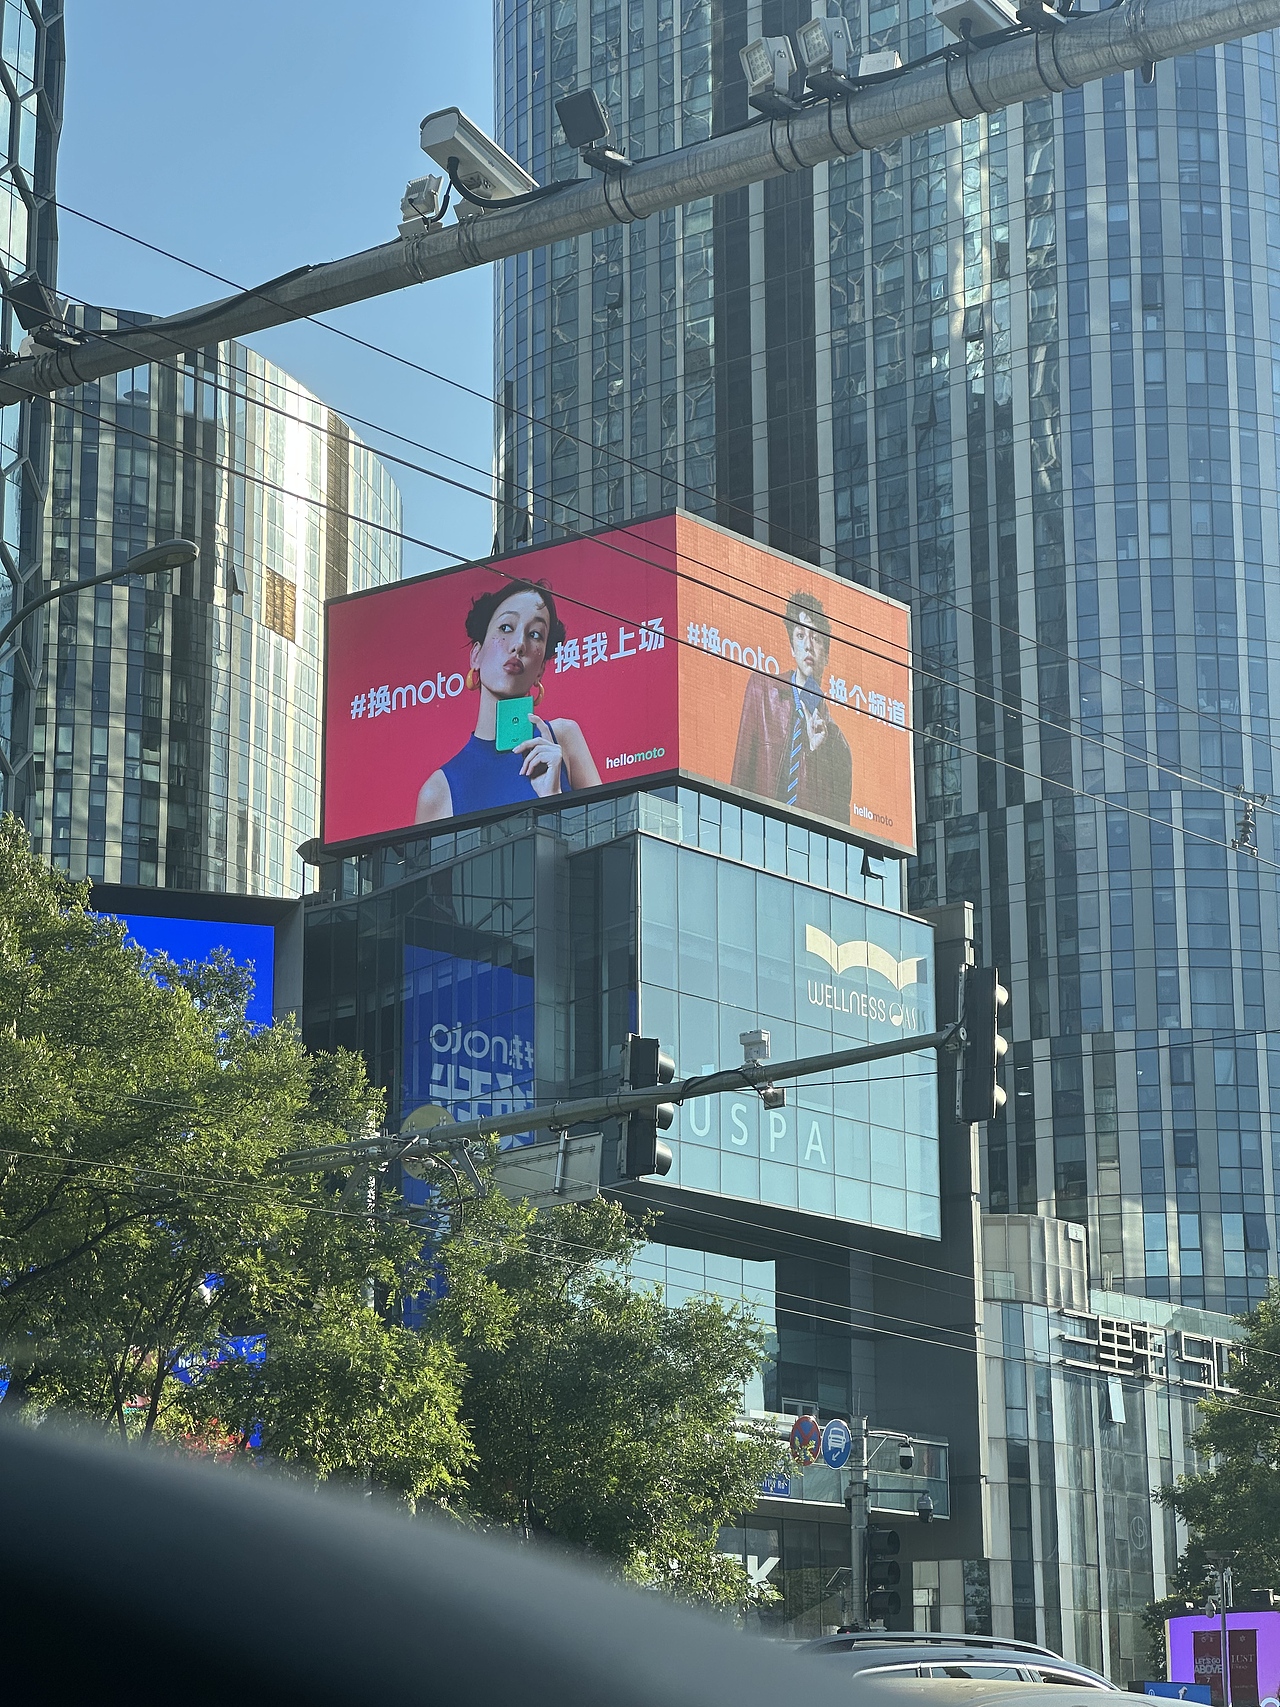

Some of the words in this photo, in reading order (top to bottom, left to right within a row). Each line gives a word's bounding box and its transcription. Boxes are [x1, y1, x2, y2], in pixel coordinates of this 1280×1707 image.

[350, 671, 465, 720] #换moto
[554, 616, 666, 674] 换我上场
[686, 621, 780, 675] #换moto
[828, 674, 907, 733] 换个频道
[605, 745, 666, 770] hellomoto
[852, 803, 894, 828] hellomoto
[807, 979, 887, 1023] WELLNESS
[1194, 1665, 1222, 1674] ABOVE
